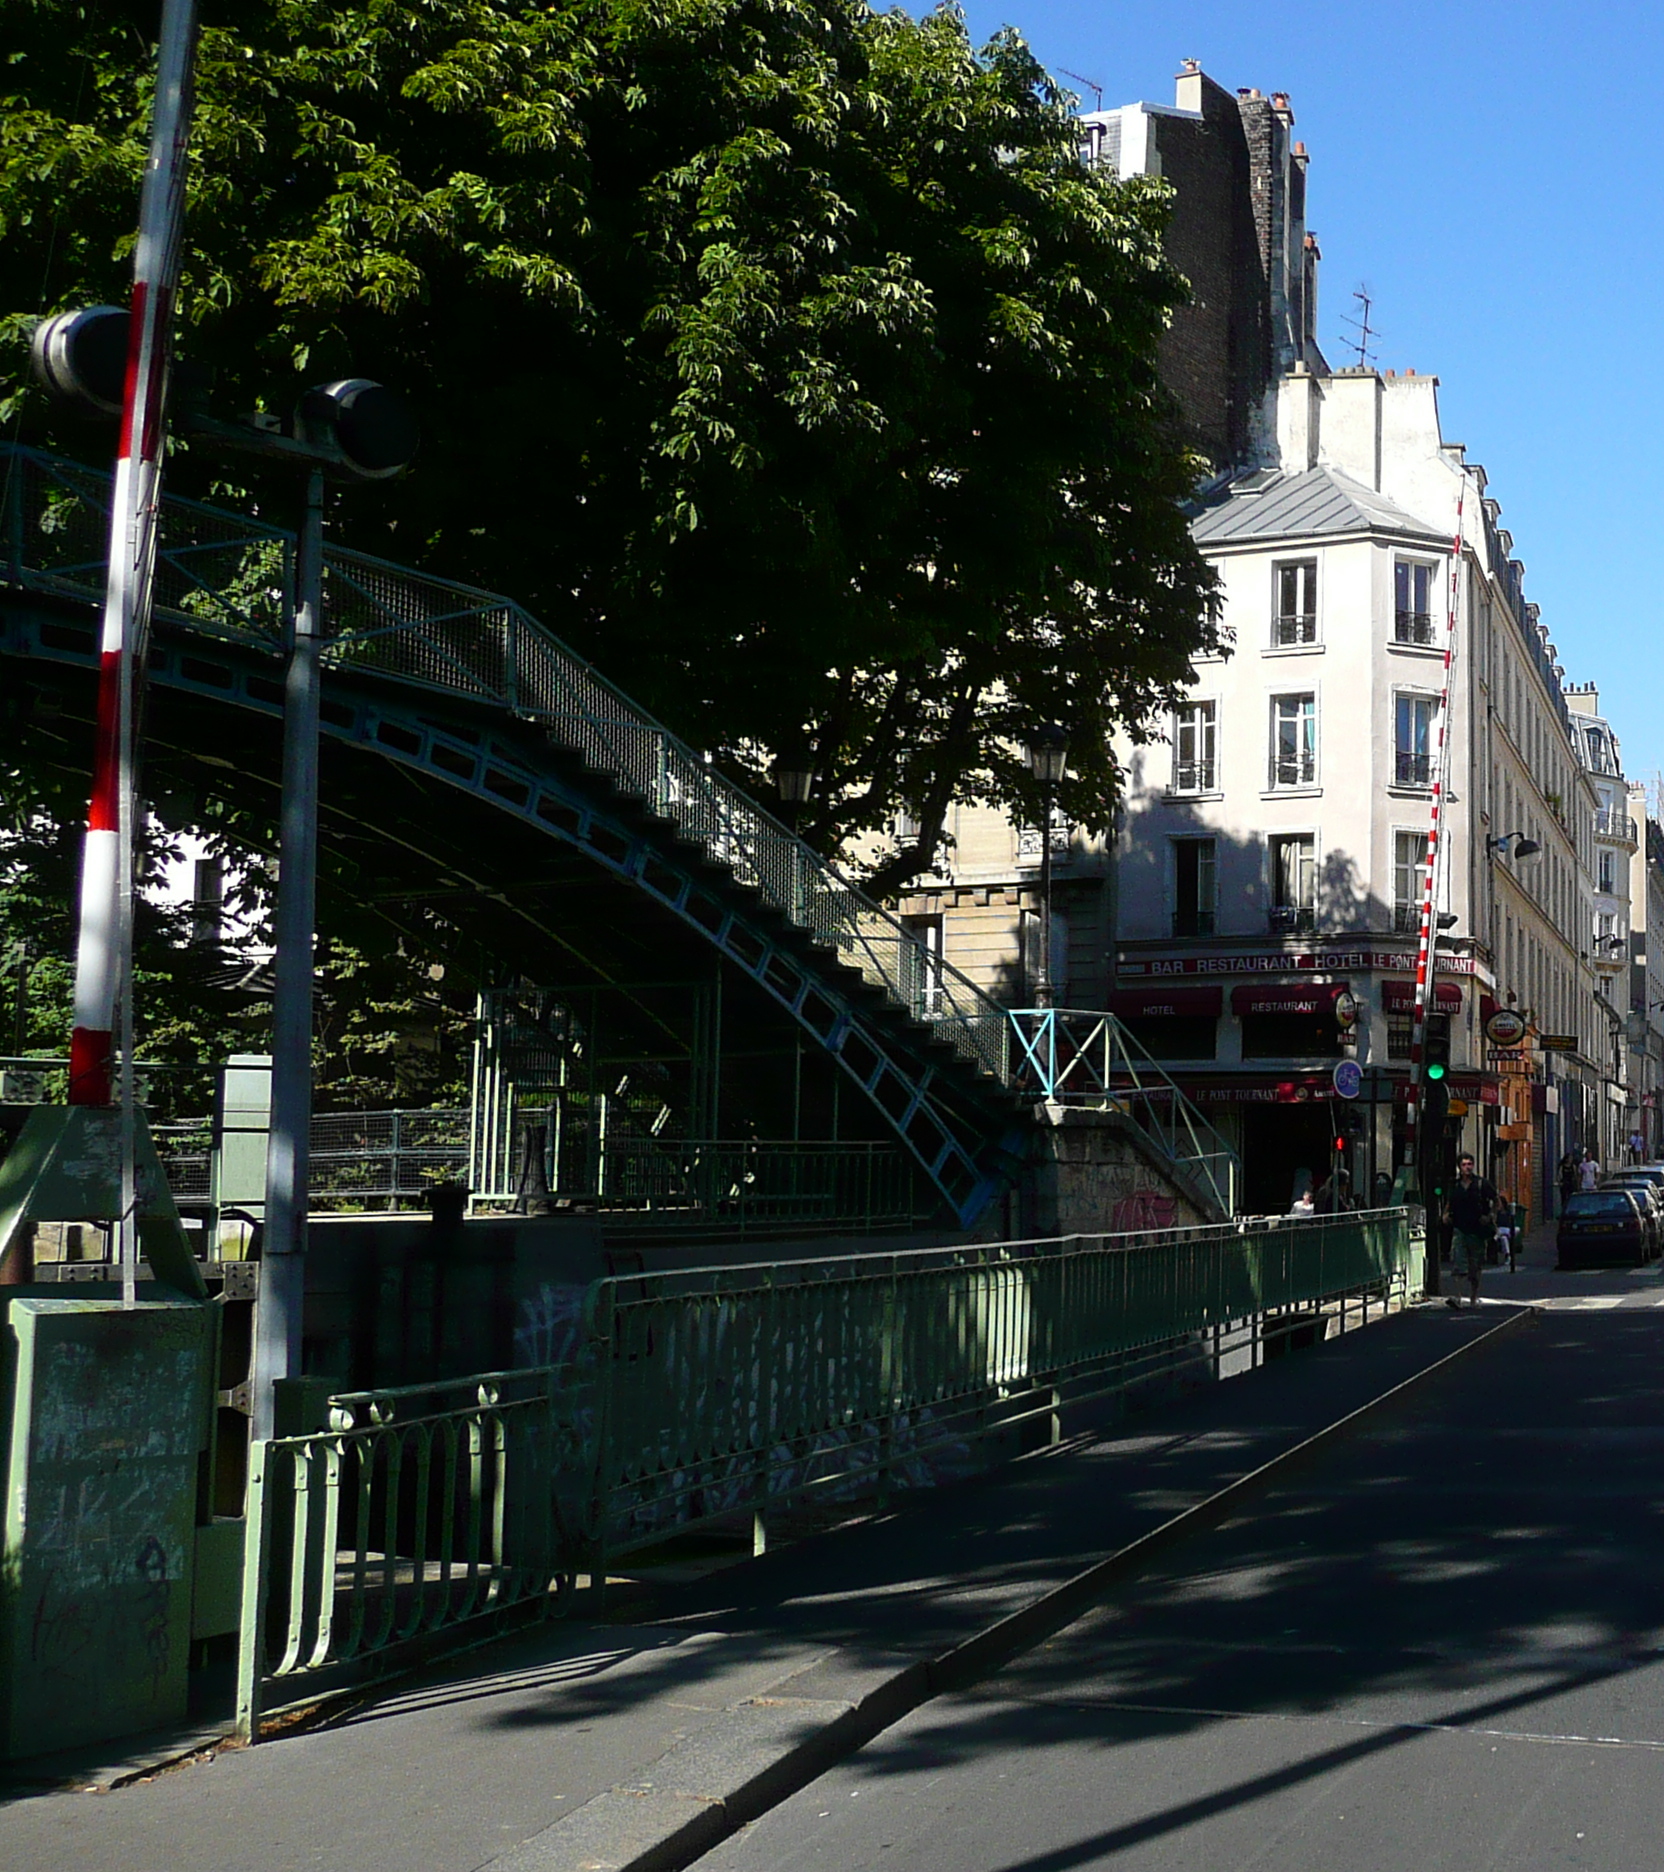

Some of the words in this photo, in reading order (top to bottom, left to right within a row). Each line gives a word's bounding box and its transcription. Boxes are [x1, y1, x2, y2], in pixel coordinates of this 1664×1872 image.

[1151, 961, 1184, 975] BAR
[1197, 955, 1302, 973] RESTAURANT
[1314, 954, 1369, 968] HOTEL
[1372, 954, 1385, 967] LE
[1389, 955, 1417, 968] PONT
[1143, 1005, 1175, 1015] HOTEL
[1251, 1000, 1319, 1013] RESTAURANT
[1488, 1051, 1523, 1060] BAR
[1196, 1089, 1206, 1101] LE
[1209, 1089, 1231, 1101] PONT
[1235, 1088, 1280, 1101] TOURNANT
